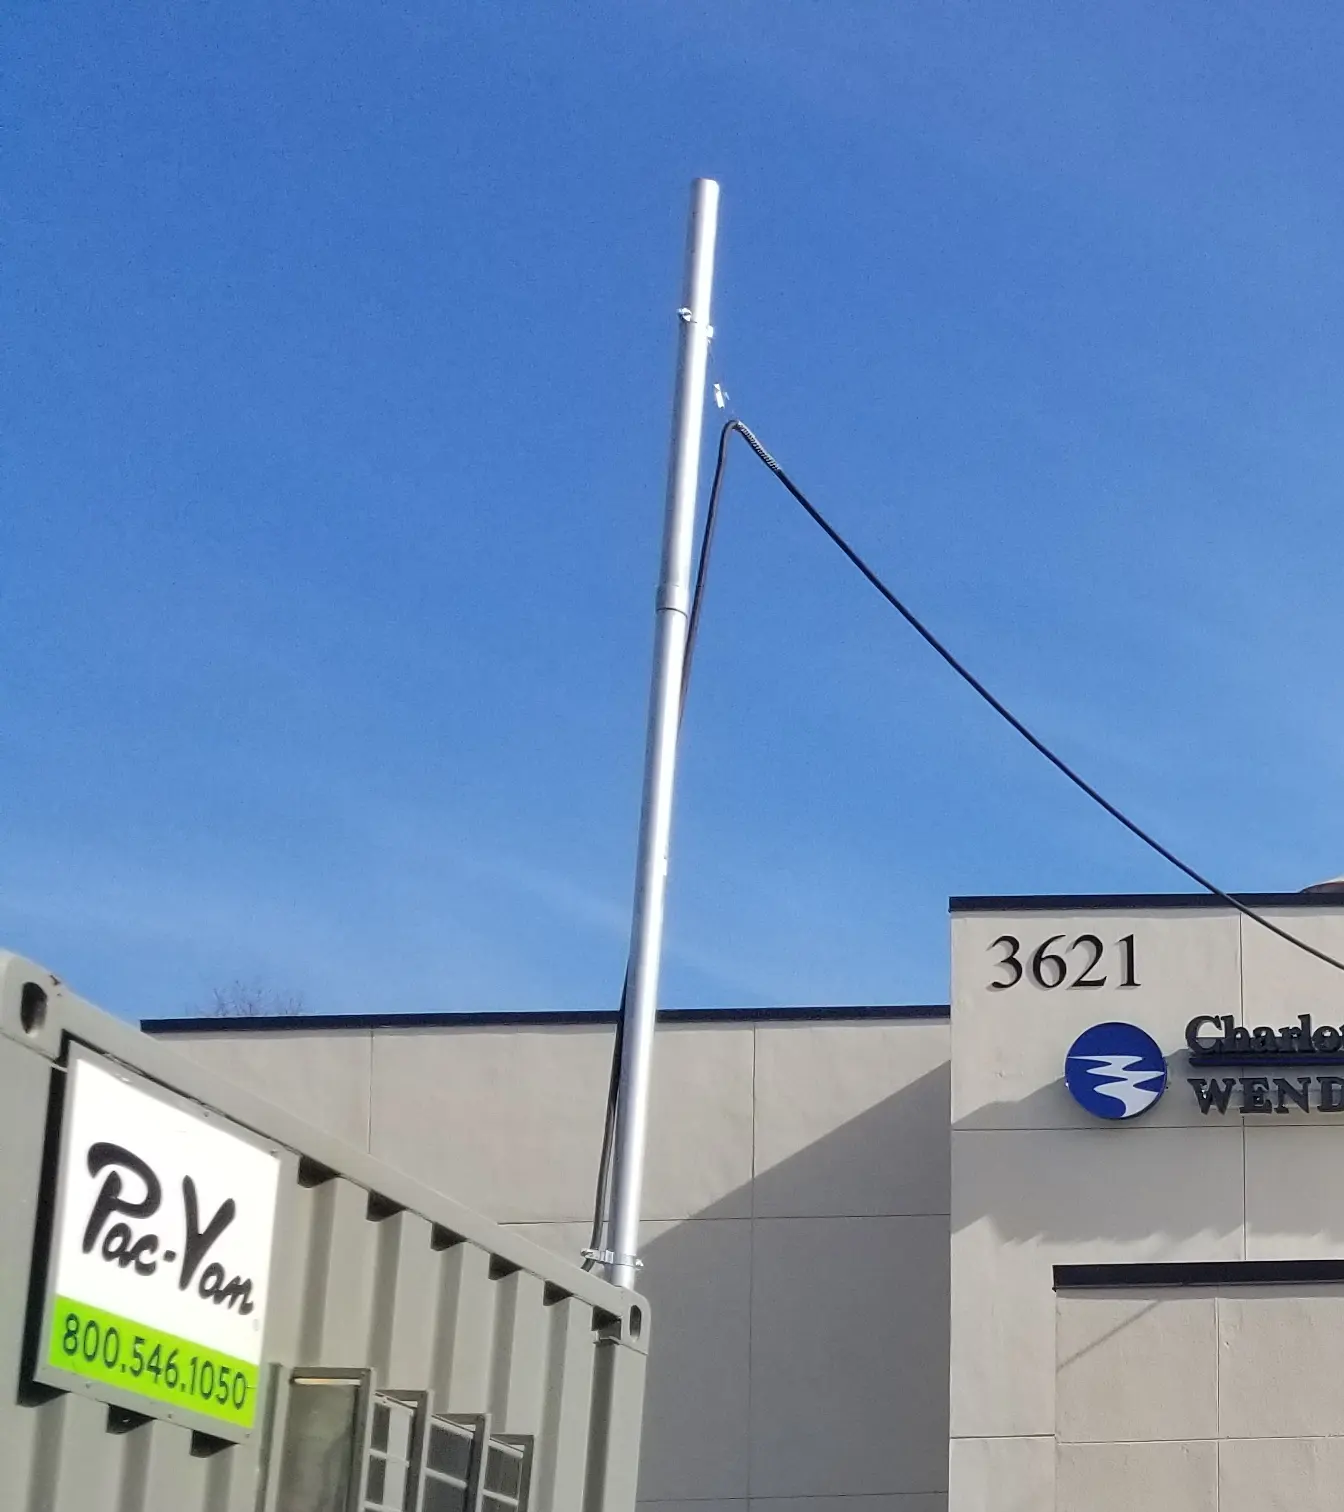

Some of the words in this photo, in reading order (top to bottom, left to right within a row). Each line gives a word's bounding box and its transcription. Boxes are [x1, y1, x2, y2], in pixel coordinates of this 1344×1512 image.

[991, 934, 1142, 989] 3621
[82, 1141, 254, 1315] Pac-Van
[63, 1313, 247, 1410] 800.546.1050
